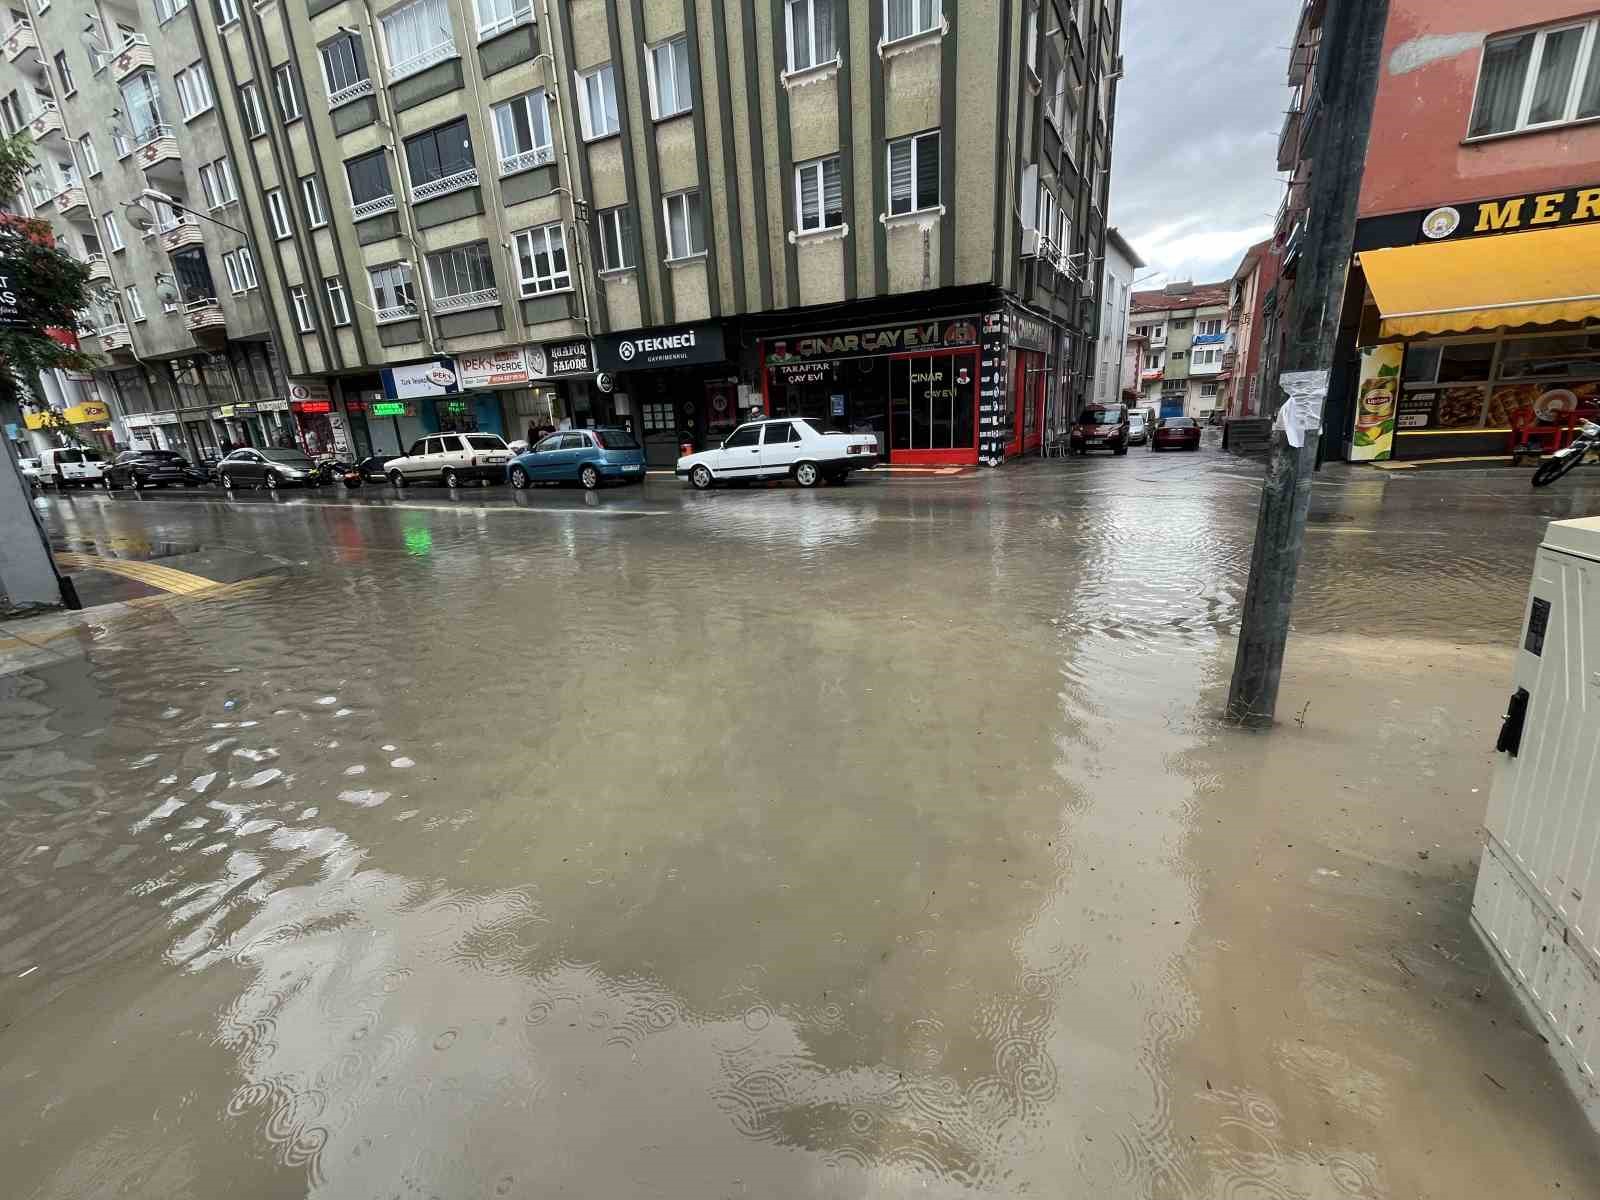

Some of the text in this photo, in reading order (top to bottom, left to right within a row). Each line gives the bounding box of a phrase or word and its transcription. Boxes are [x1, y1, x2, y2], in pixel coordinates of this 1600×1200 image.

[635, 330, 696, 352] TEKNECİ
[800, 322, 939, 357] ÇINAR ÇAY EVİ
[496, 361, 523, 372] PERDE
[553, 358, 588, 373] SALONU
[781, 362, 831, 374] TARAFTAR
[788, 372, 824, 384] ÇAY EVİ
[910, 371, 944, 384] ÇINAR
